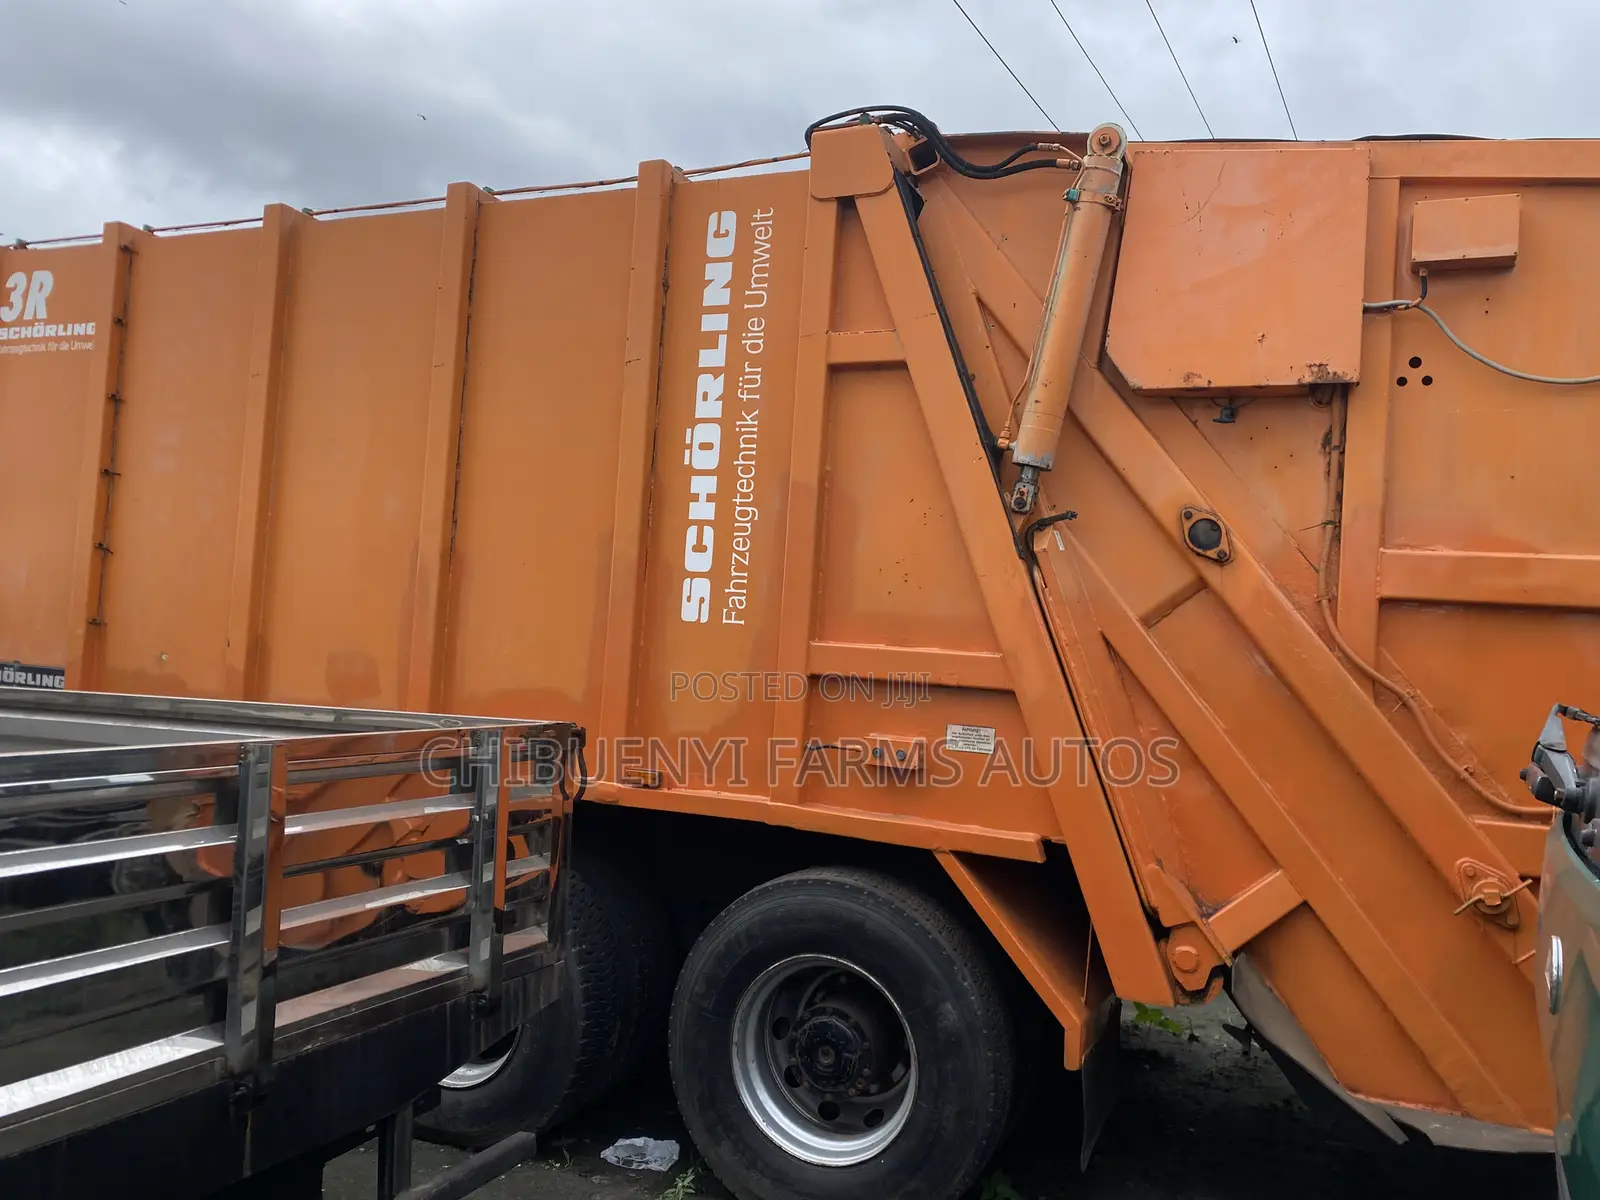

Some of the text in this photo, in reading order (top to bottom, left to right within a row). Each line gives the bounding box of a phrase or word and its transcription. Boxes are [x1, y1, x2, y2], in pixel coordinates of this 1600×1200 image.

[0, 270, 54, 322] 3R
[680, 210, 737, 624] SCHÖRLING
[722, 206, 774, 625] Fahrzeugtechnik für die Umwelt
[0, 666, 65, 688] ÖRLING
